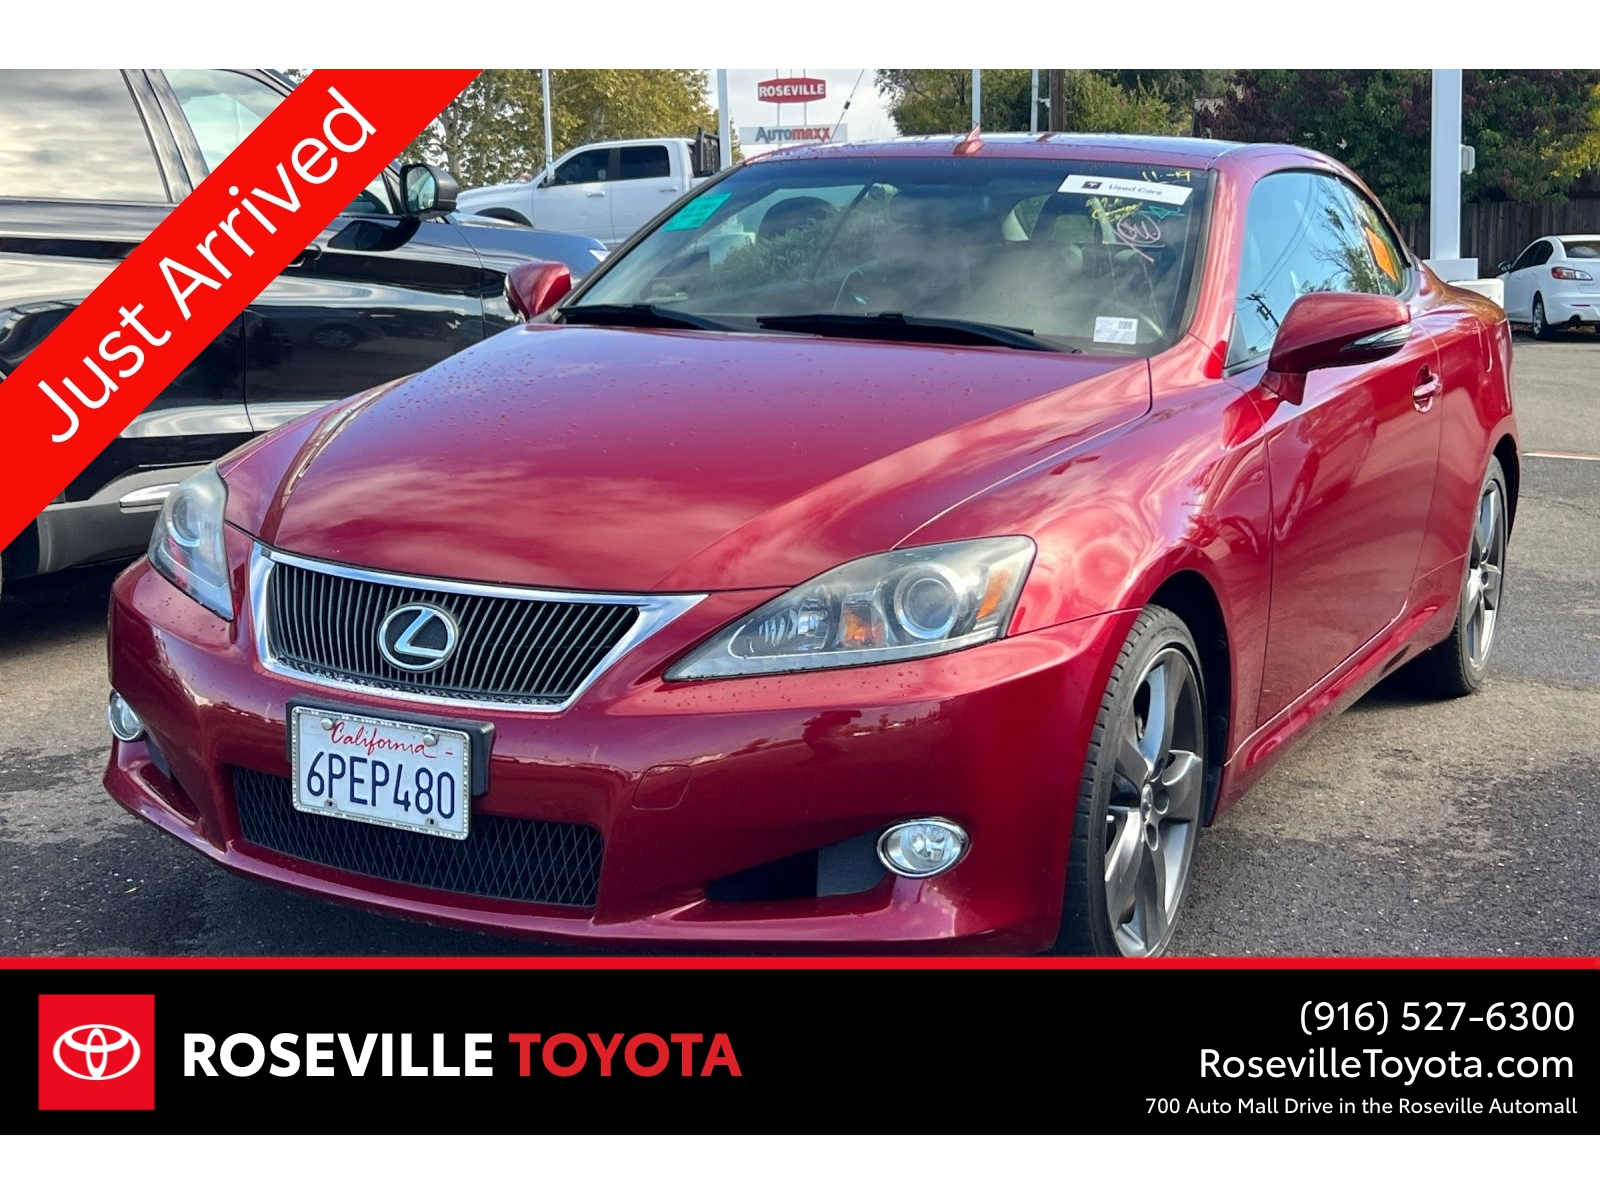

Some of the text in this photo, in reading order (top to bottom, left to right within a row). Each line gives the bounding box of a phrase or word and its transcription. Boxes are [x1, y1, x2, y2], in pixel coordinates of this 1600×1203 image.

[758, 83, 825, 98] ROSEVILLE
[330, 721, 437, 759] California
[306, 751, 455, 819] 6PEP480
